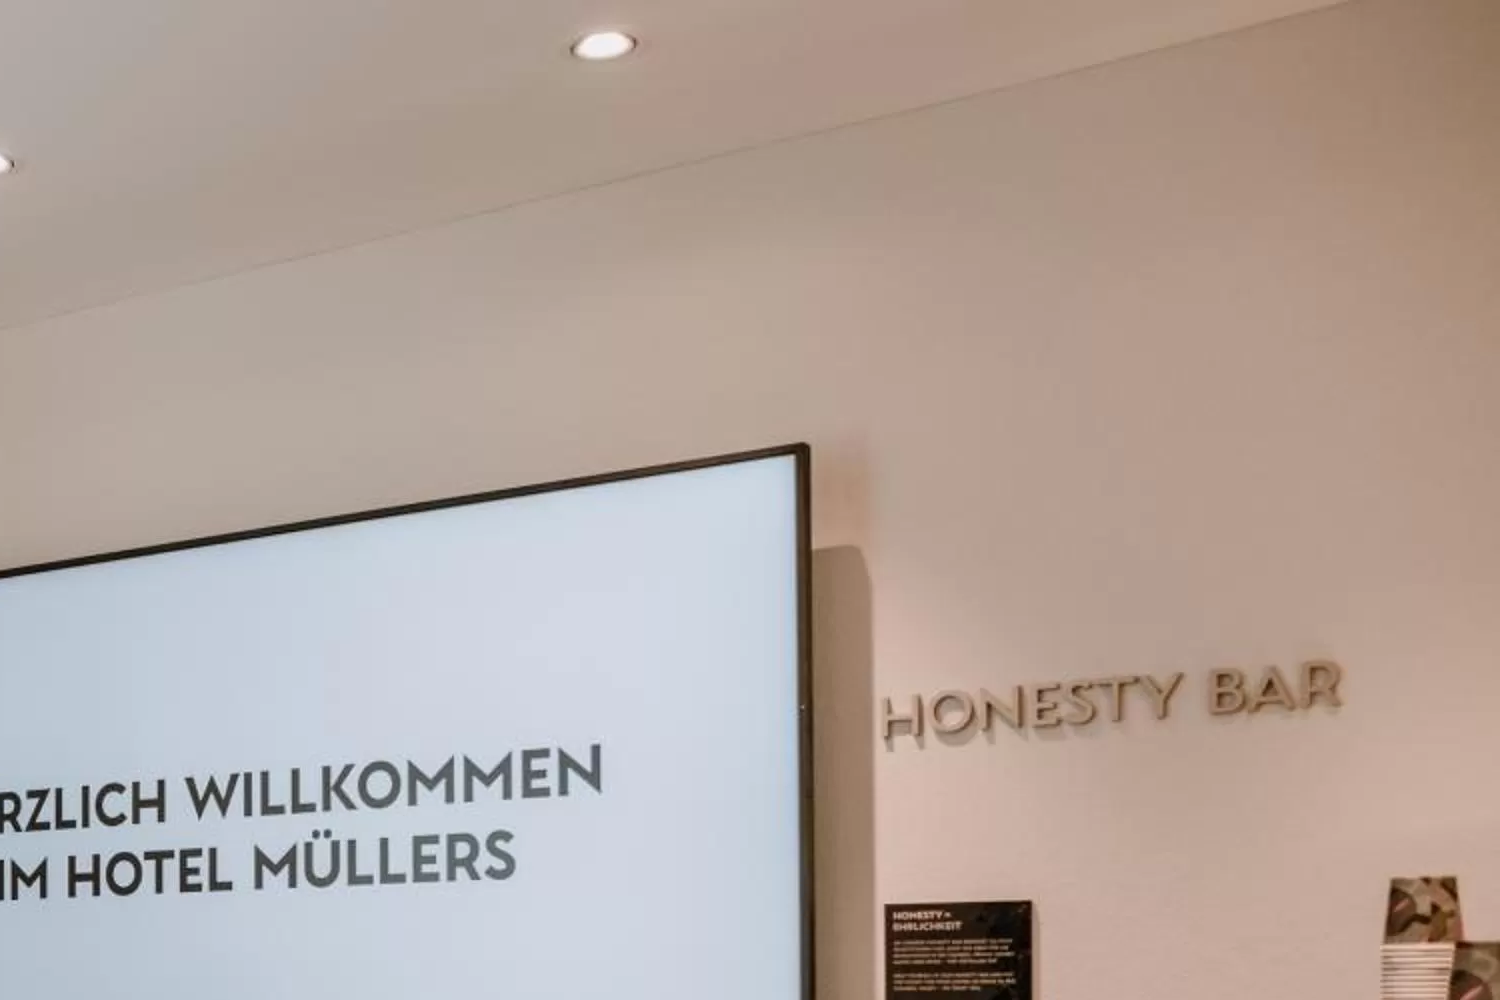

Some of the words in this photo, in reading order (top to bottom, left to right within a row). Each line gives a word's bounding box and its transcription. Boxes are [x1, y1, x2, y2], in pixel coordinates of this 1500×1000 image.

[882, 671, 1185, 739] HONESTY
[1208, 660, 1343, 716] BAR
[185, 743, 602, 820] WILLKOMMEN
[67, 847, 234, 898] HOTEL
[253, 828, 517, 890] MÜLLERS
[892, 909, 943, 921] HONESTY
